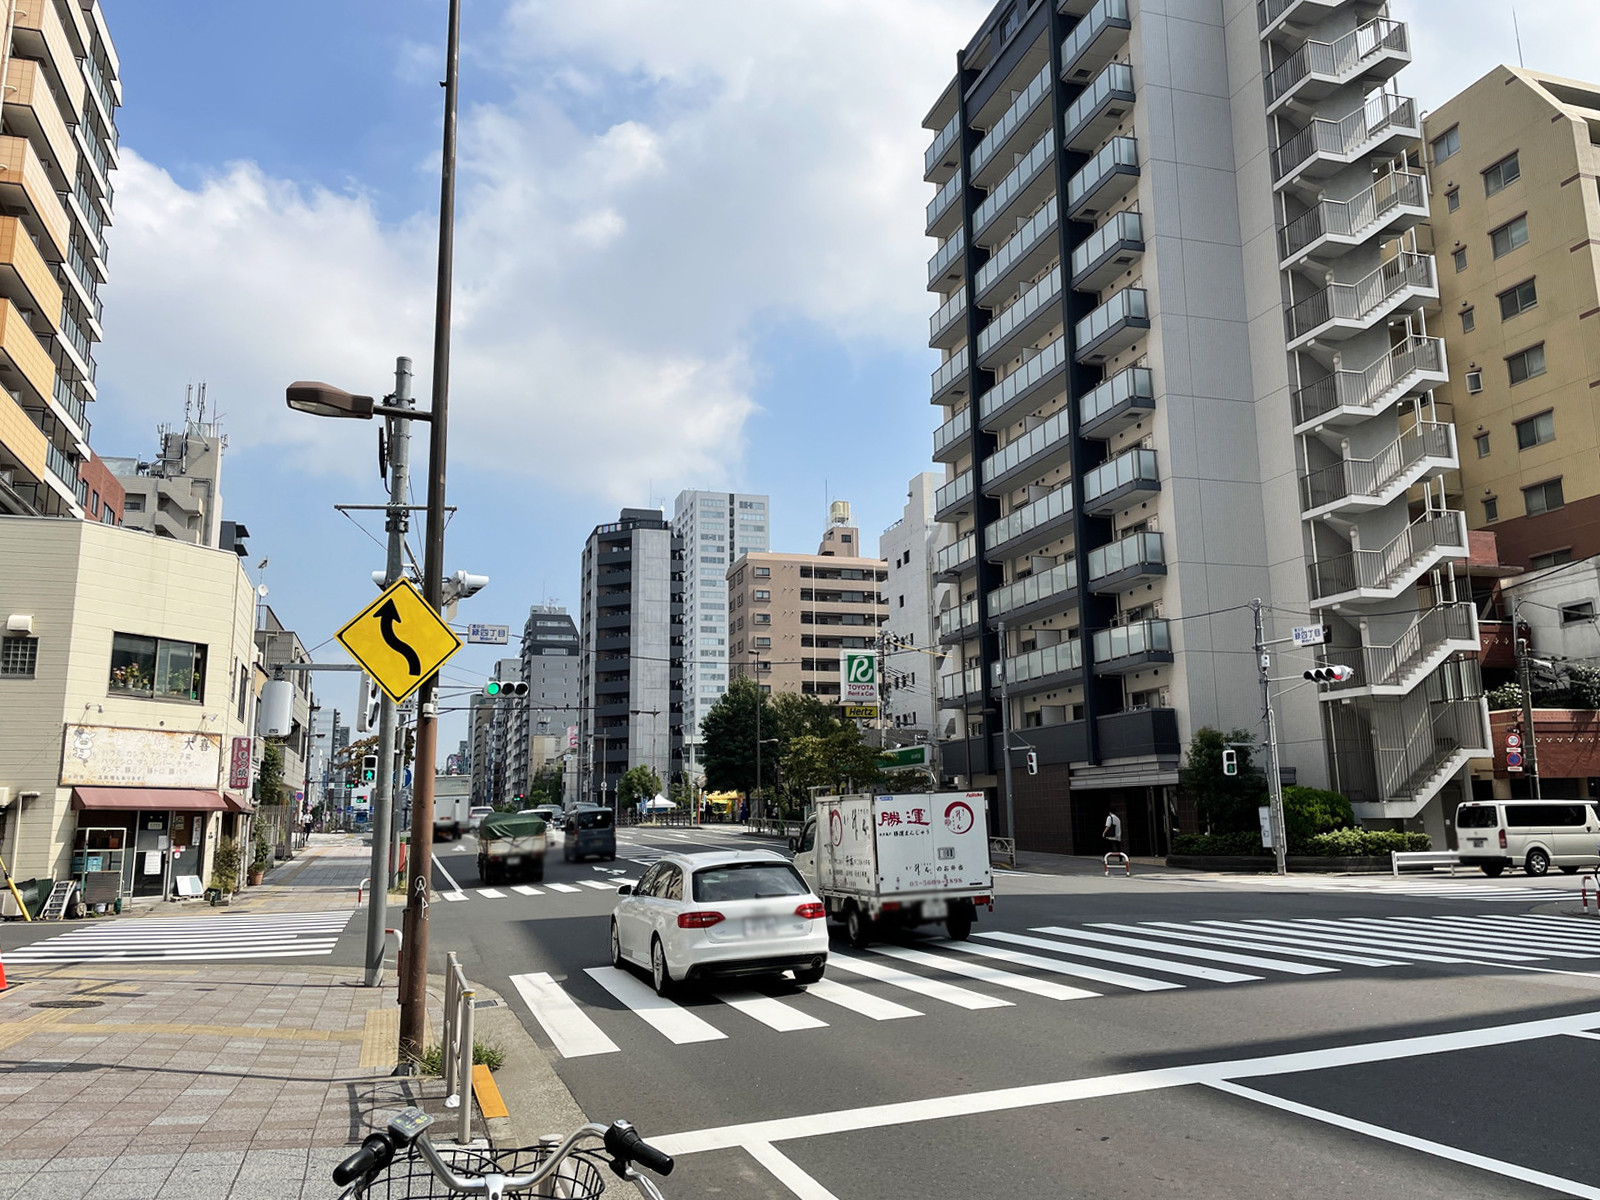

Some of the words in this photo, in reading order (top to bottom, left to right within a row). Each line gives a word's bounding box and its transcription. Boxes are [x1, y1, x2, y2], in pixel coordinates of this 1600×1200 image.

[849, 707, 873, 716] Hertz
[184, 737, 210, 751] 大喜
[878, 808, 930, 827] 勝運
